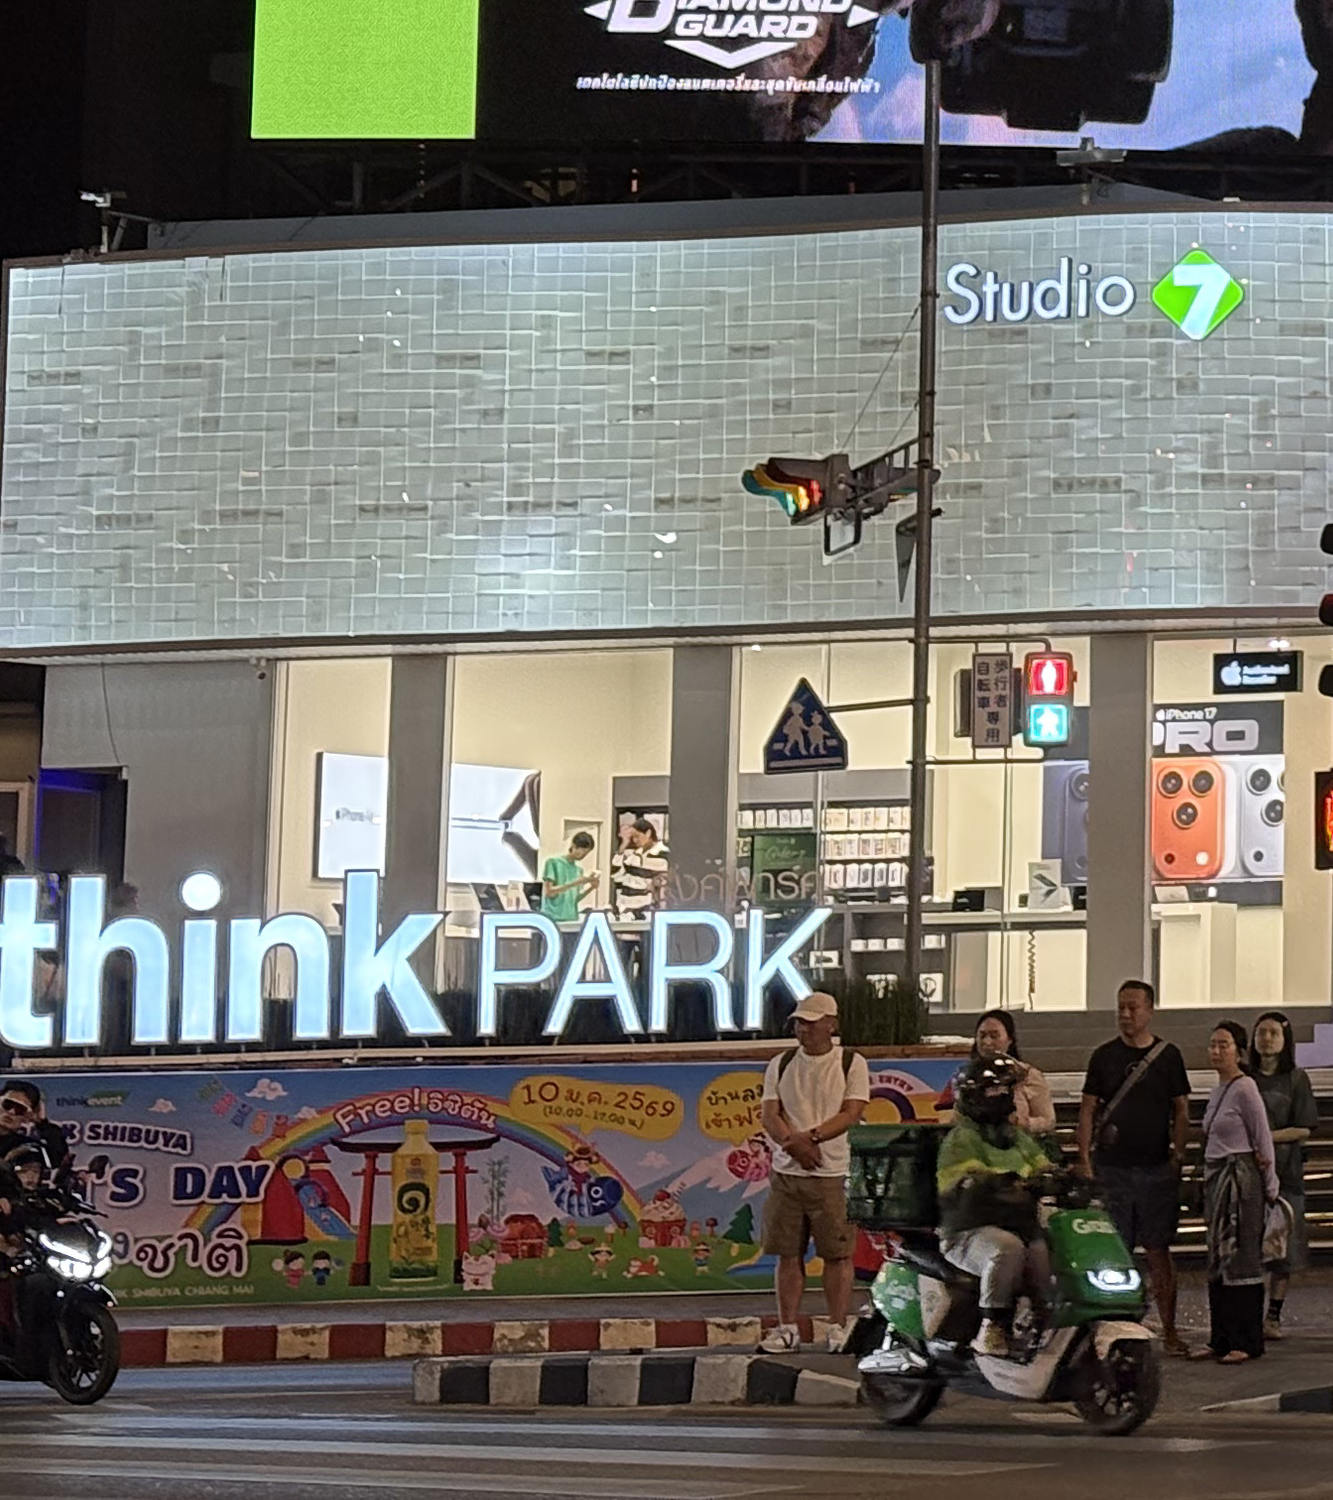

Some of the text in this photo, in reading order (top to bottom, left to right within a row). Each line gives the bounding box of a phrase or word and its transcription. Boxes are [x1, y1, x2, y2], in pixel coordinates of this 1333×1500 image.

[674, 14, 818, 38] GUARD
[944, 256, 1231, 340] Studio 7
[0, 869, 834, 1048] think PARK
[334, 1086, 421, 1135] Free!
[521, 1081, 560, 1106] 10
[614, 1090, 676, 1118] 2569
[86, 1123, 191, 1152] SHIBUYA
[172, 1163, 273, 1204] DAY
